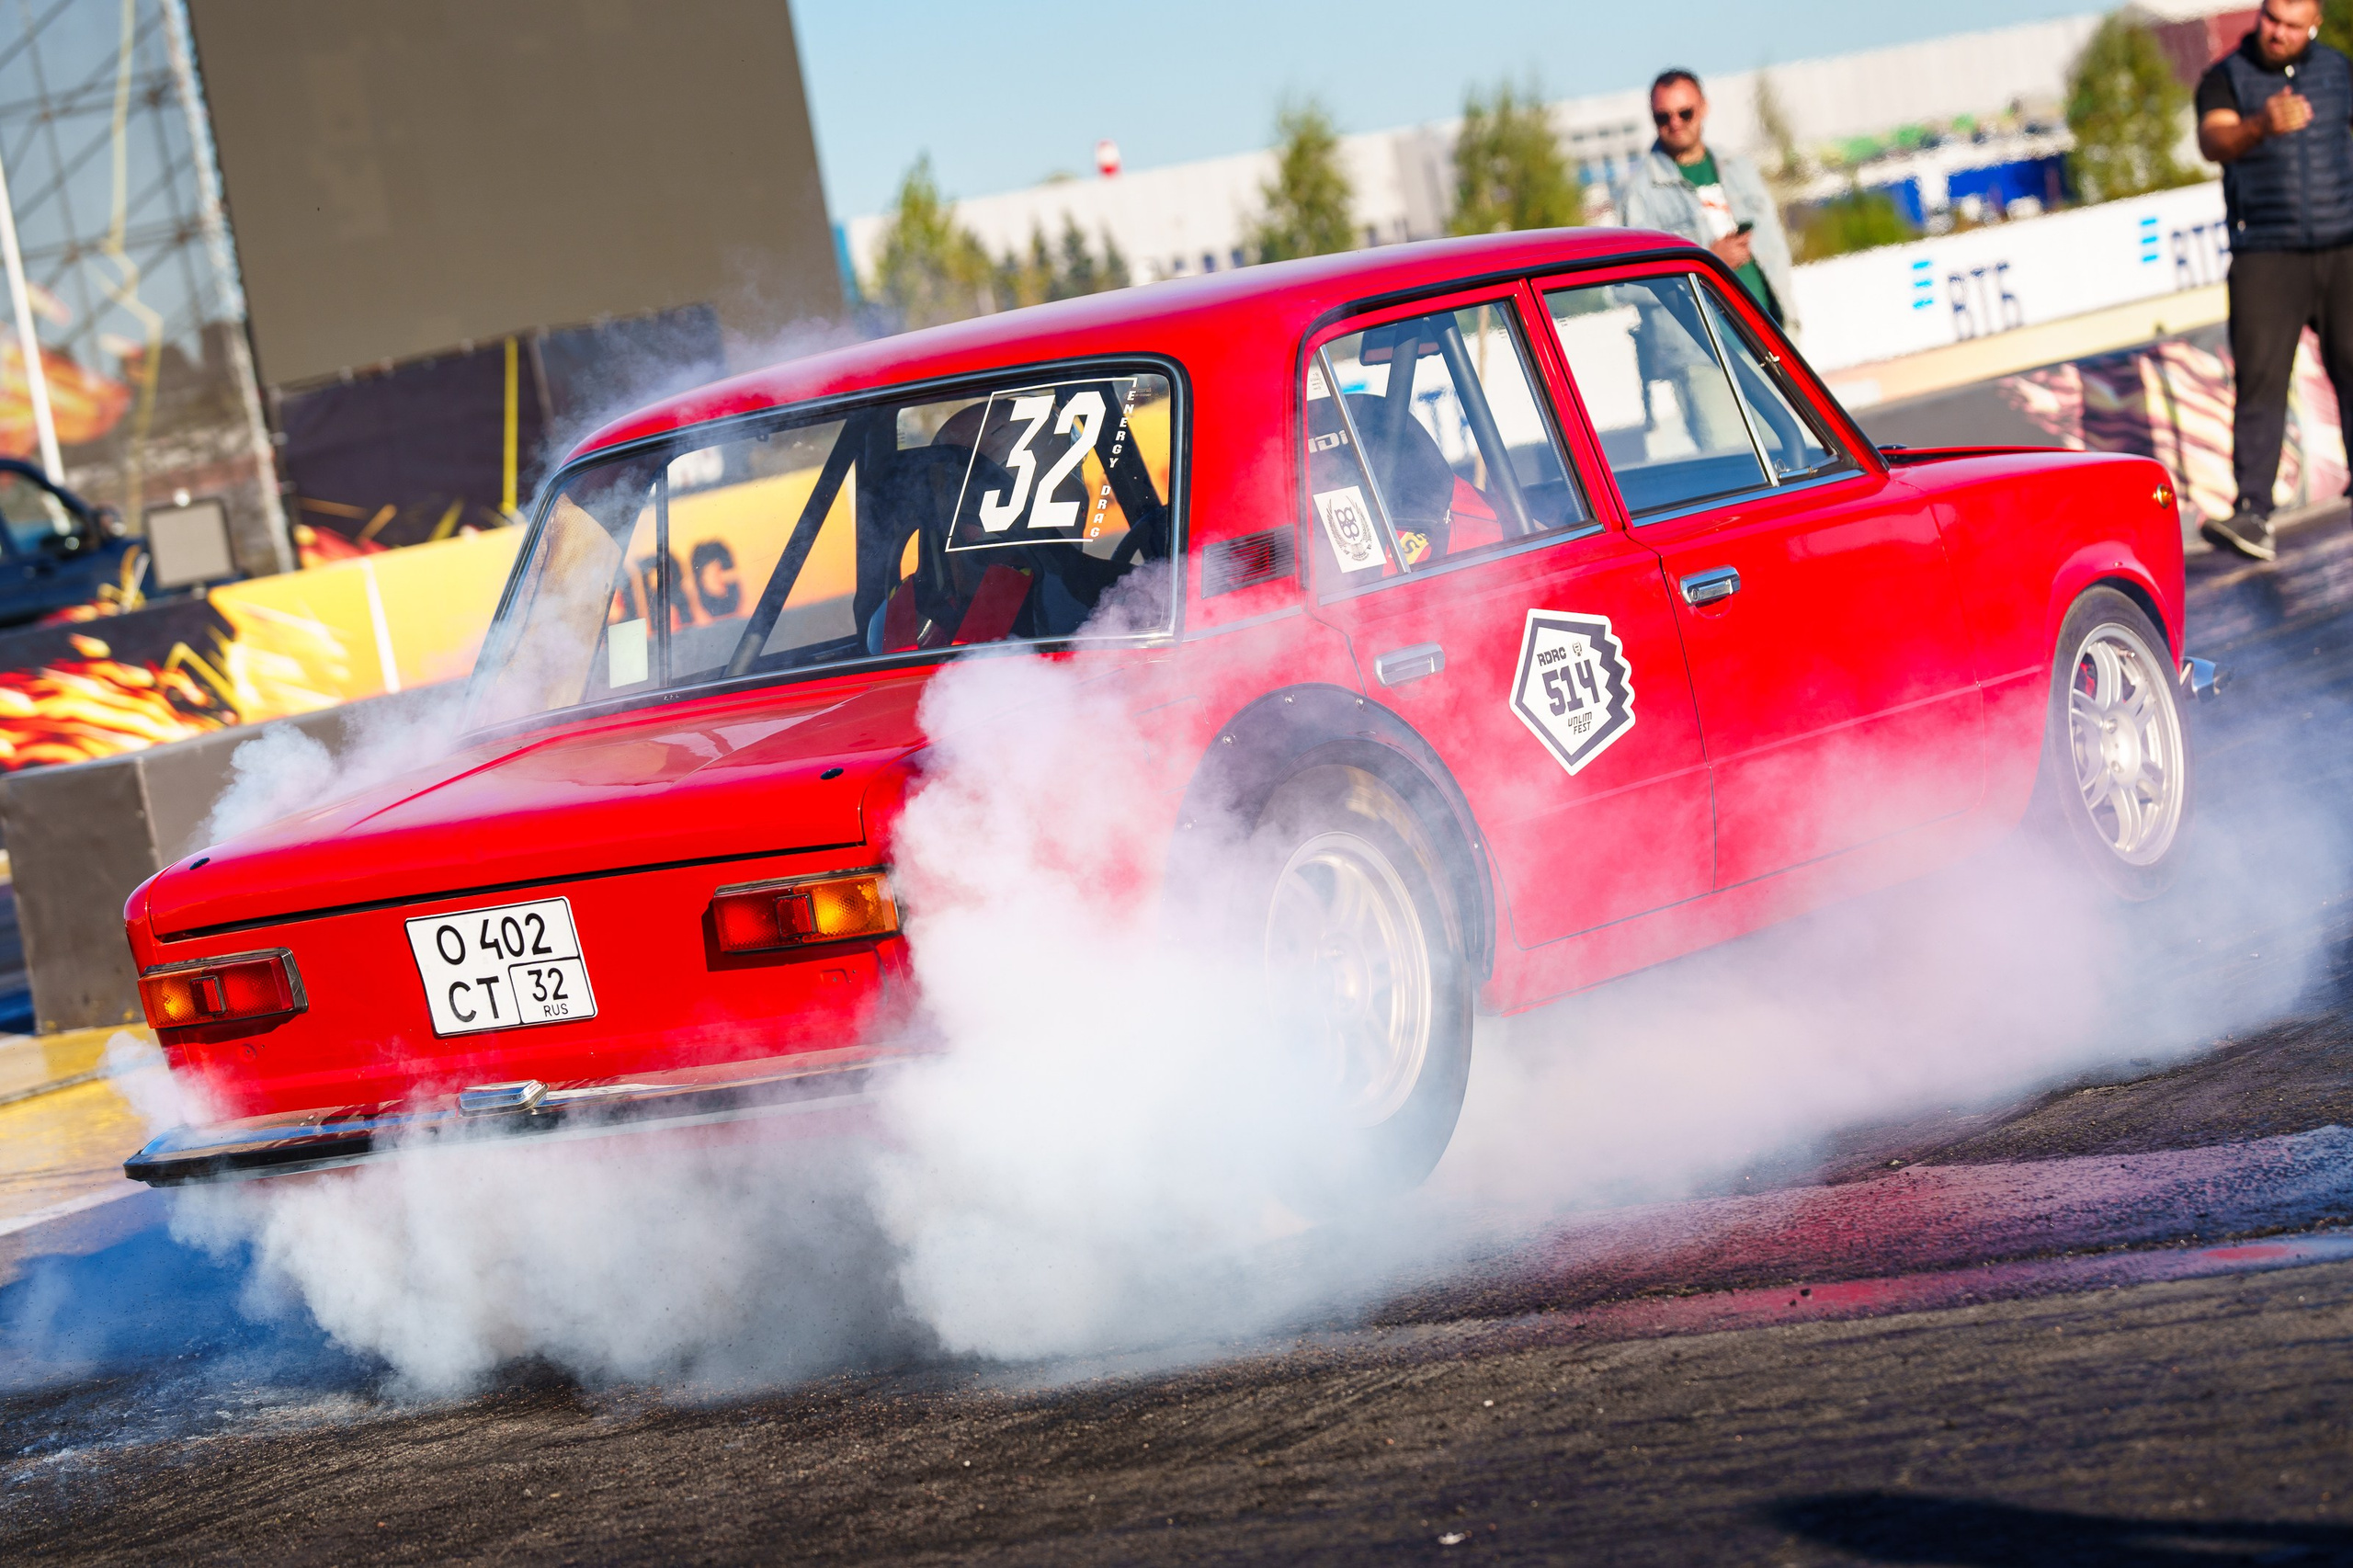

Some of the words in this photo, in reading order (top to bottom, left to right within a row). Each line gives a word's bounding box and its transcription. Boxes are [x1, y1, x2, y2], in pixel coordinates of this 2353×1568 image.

[1109, 391, 1137, 469] ENERGY
[979, 391, 1107, 533] 32
[1090, 485, 1111, 538] DRAG
[1537, 646, 1567, 667] RDRC
[1541, 658, 1601, 717] 514
[1574, 722, 1592, 735] FEST
[480, 913, 553, 960] 402
[528, 967, 569, 1003] 32
[543, 1003, 569, 1017] RUS
